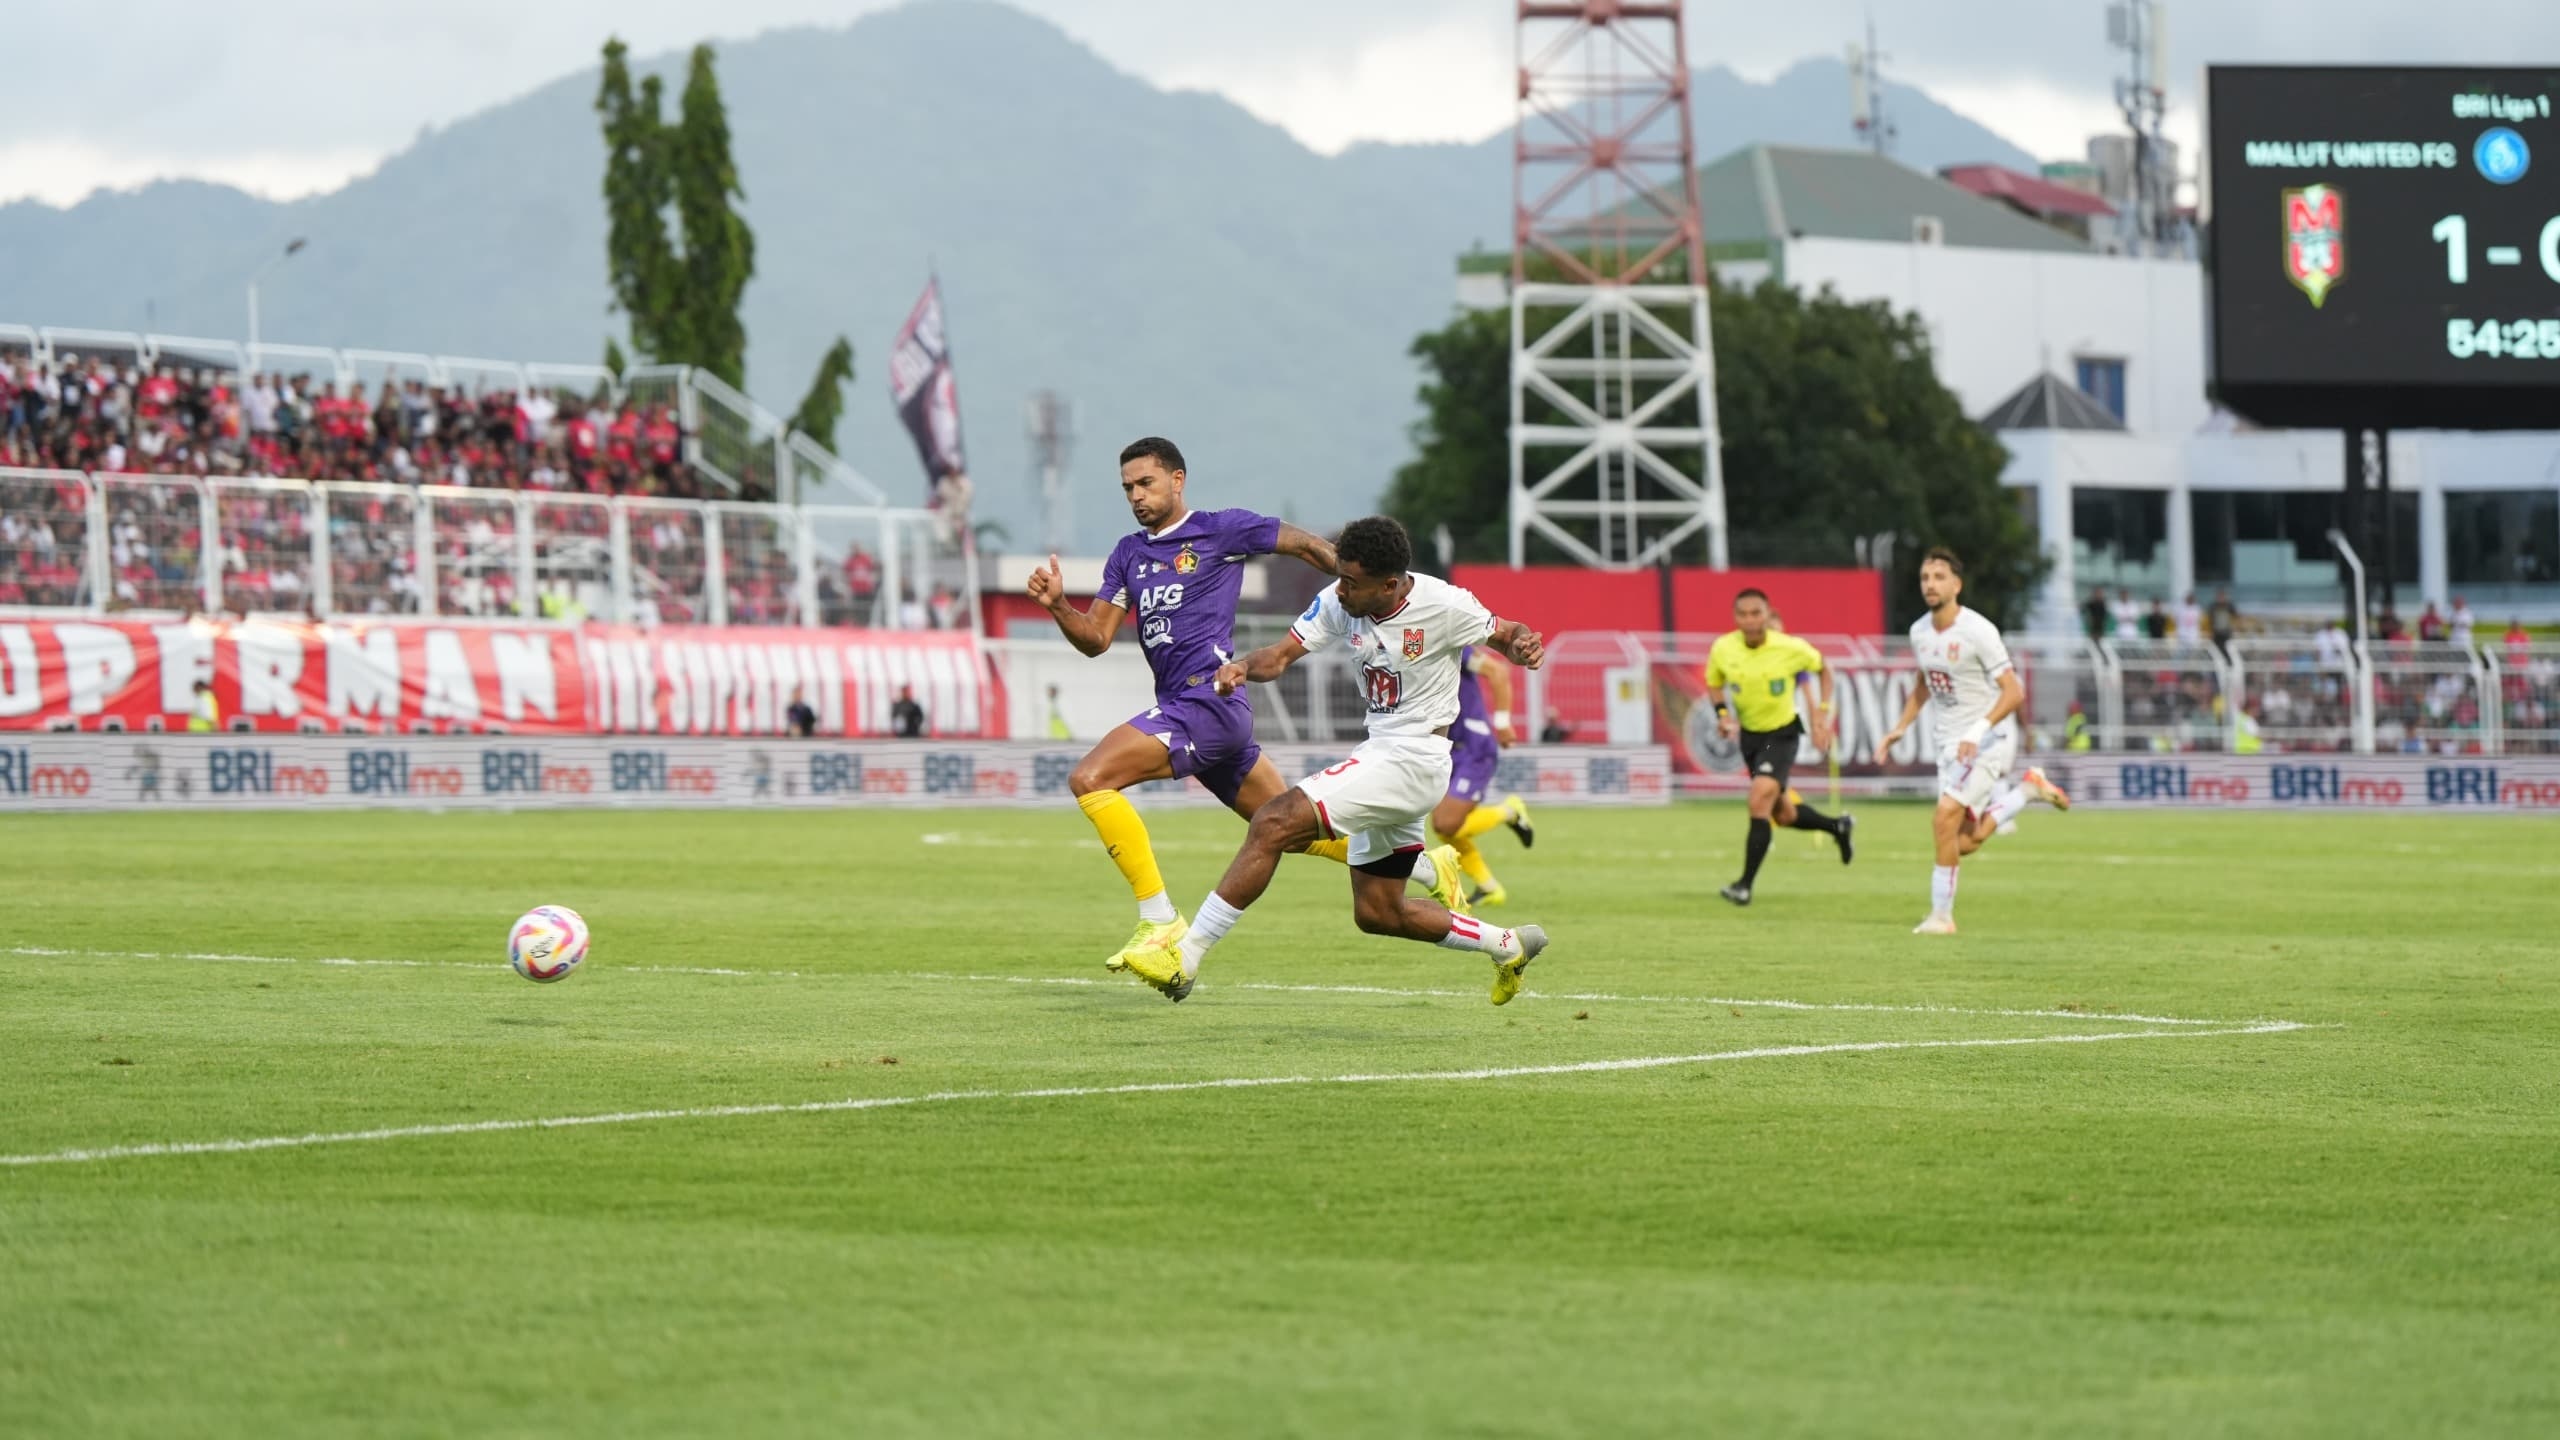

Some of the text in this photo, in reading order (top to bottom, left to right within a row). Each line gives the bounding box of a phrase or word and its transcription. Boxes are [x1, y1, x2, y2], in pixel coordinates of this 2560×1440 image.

[2245, 141, 2457, 168] MALUT UNITED FC
[2432, 214, 2468, 284] 1
[2447, 318, 2560, 359] 54:25
[1140, 584, 1184, 610] AFG
[208, 749, 328, 796] BRImo
[349, 750, 462, 795] BRImo
[482, 750, 593, 795] BRImo
[2120, 763, 2249, 802] BRImo
[2271, 765, 2404, 804] BRImo
